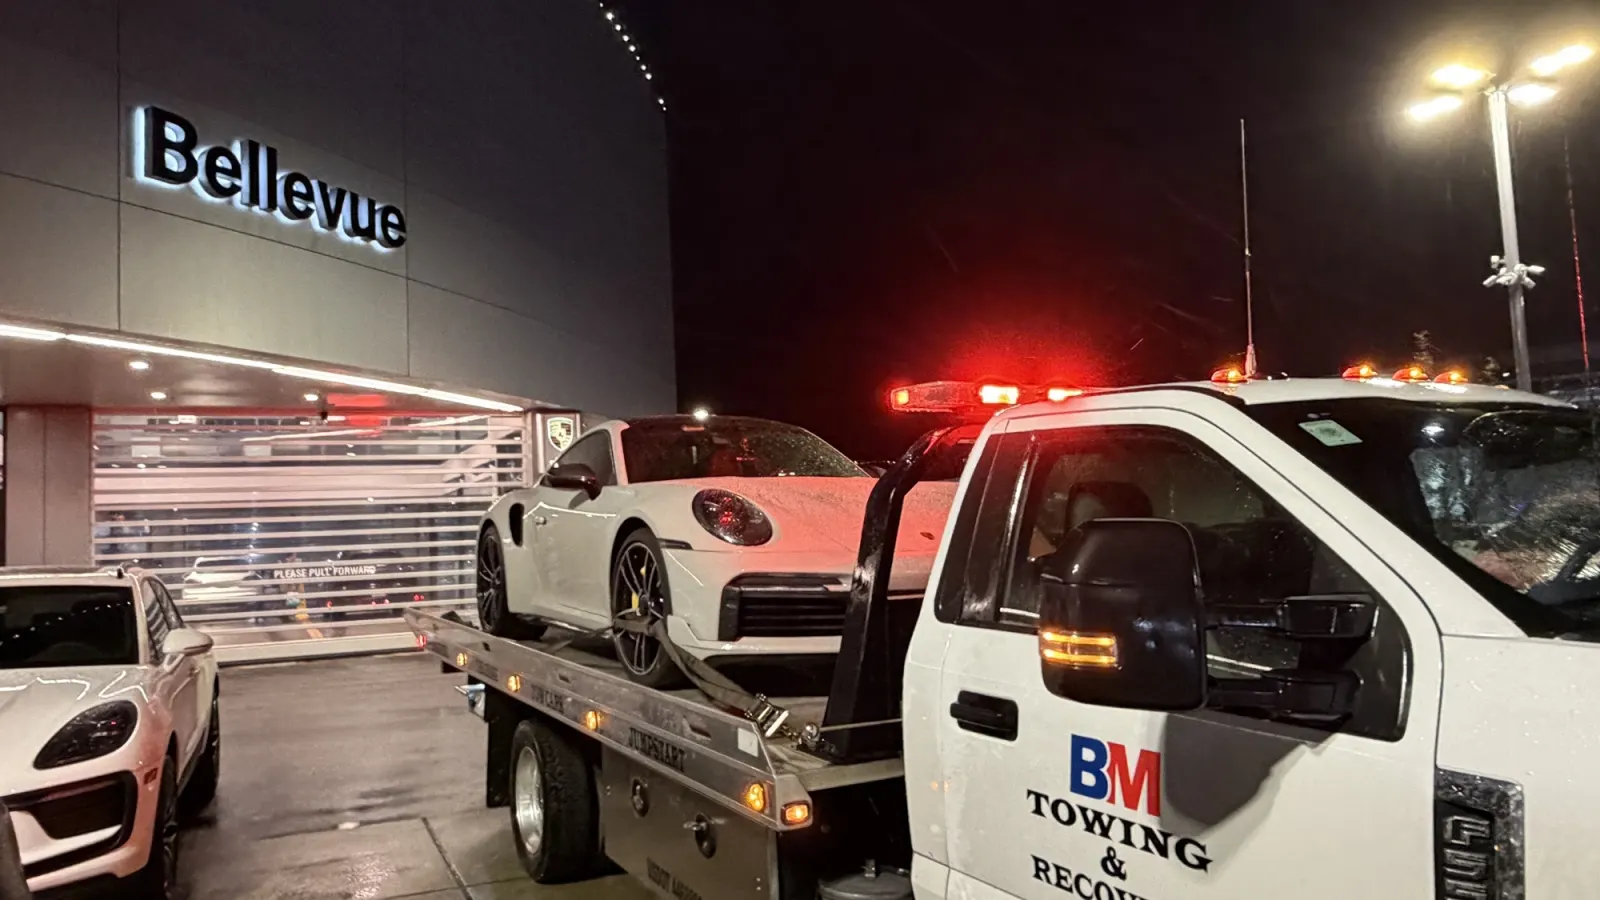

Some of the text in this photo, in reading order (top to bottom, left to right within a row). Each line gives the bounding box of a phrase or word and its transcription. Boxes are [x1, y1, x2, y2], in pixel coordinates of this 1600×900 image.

[143, 105, 407, 249] Bellevue
[273, 564, 377, 579] PLEASE PULL FORWARD
[1070, 733, 1161, 818] BM
[1026, 788, 1214, 873] TOWING
[1100, 846, 1127, 881] &
